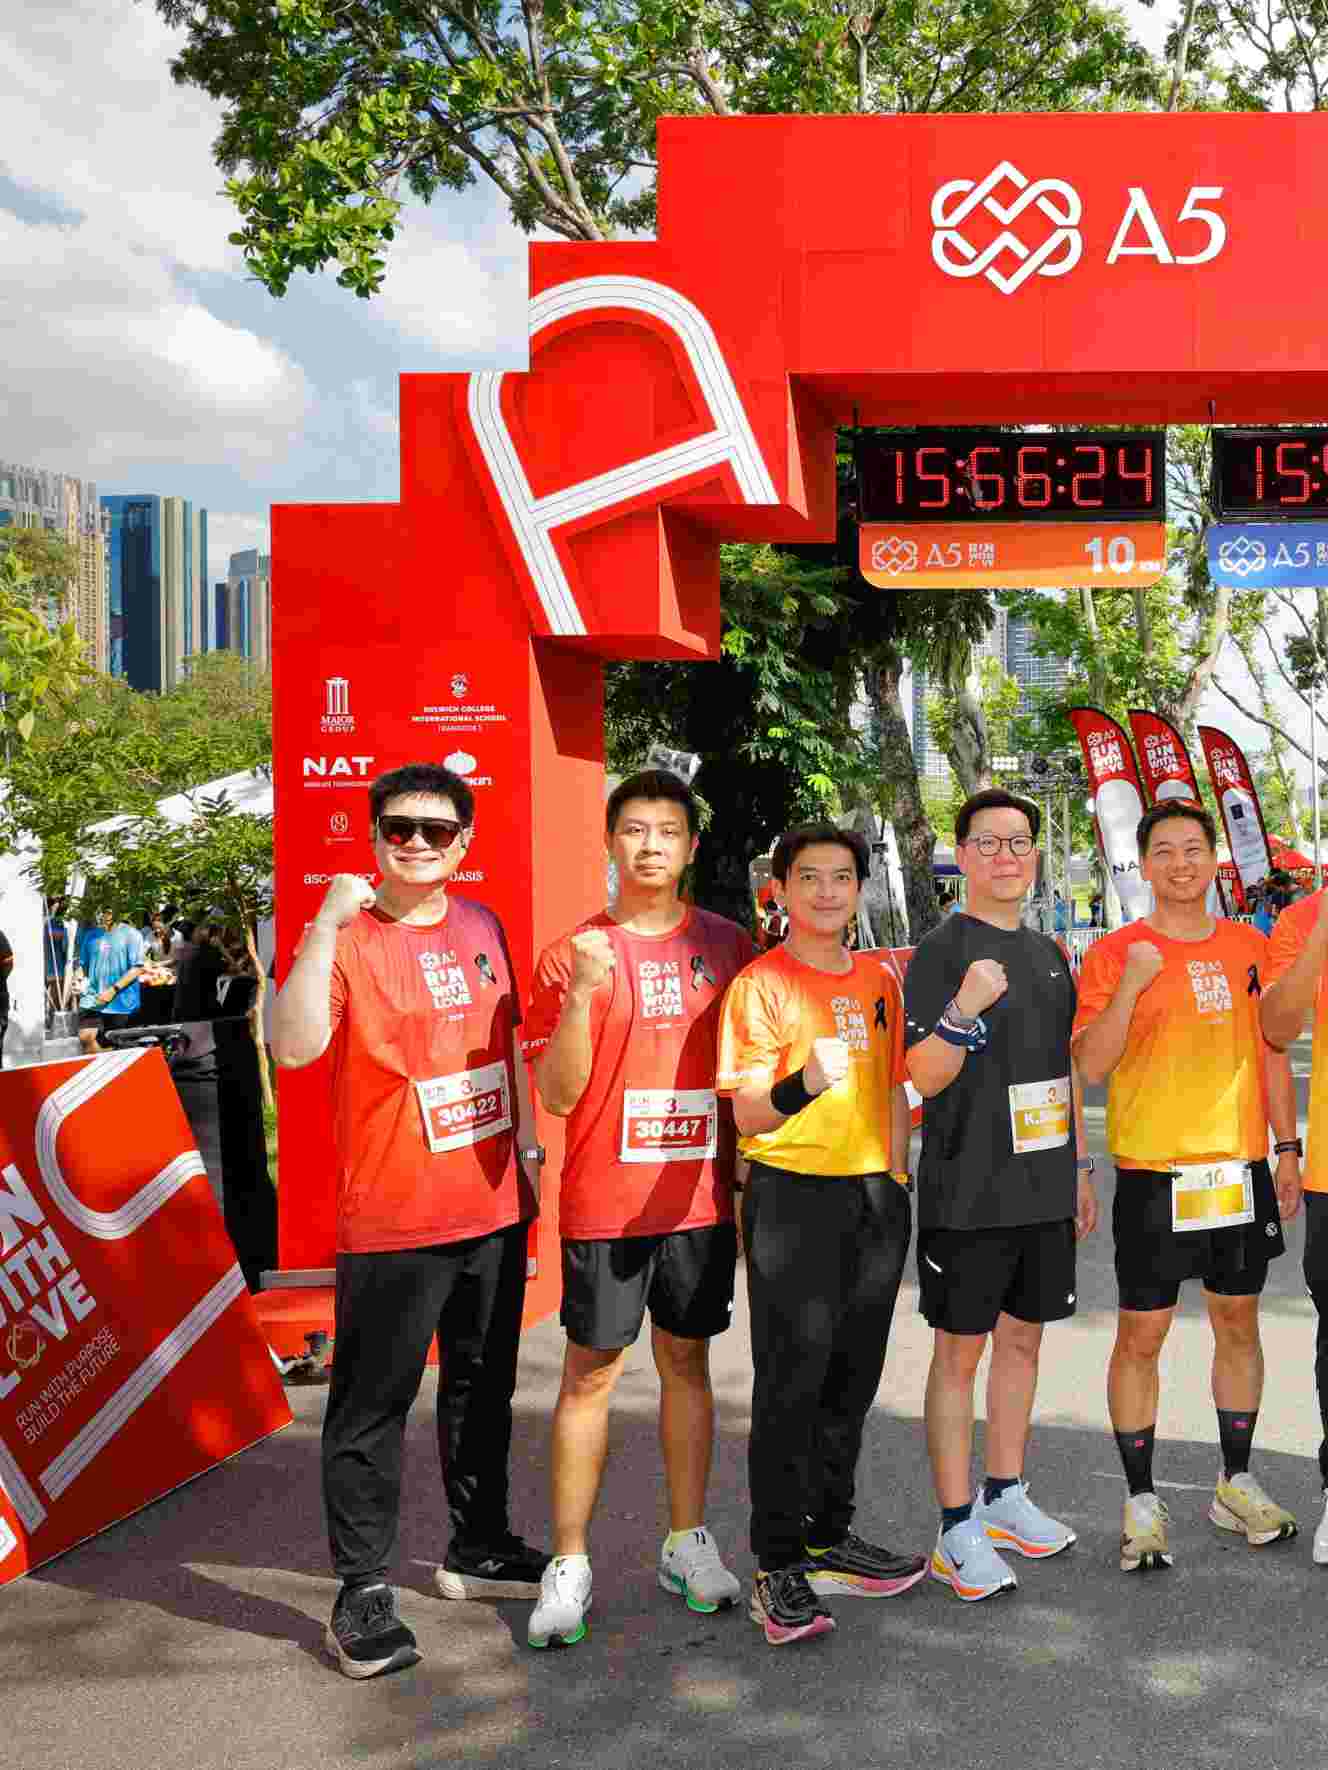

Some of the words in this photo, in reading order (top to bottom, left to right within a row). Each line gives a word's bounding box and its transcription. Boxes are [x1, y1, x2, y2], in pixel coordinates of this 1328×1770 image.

[1105, 186, 1228, 264] A5
[925, 543, 962, 568] A5
[1085, 537, 1136, 573] 10
[1272, 543, 1311, 568] A5
[304, 757, 374, 776] NAT
[461, 1080, 474, 1095] 3
[438, 1095, 498, 1126] 30422
[664, 1098, 679, 1114] 3
[636, 1119, 701, 1138] 30447
[0, 1225, 71, 1328] ITH
